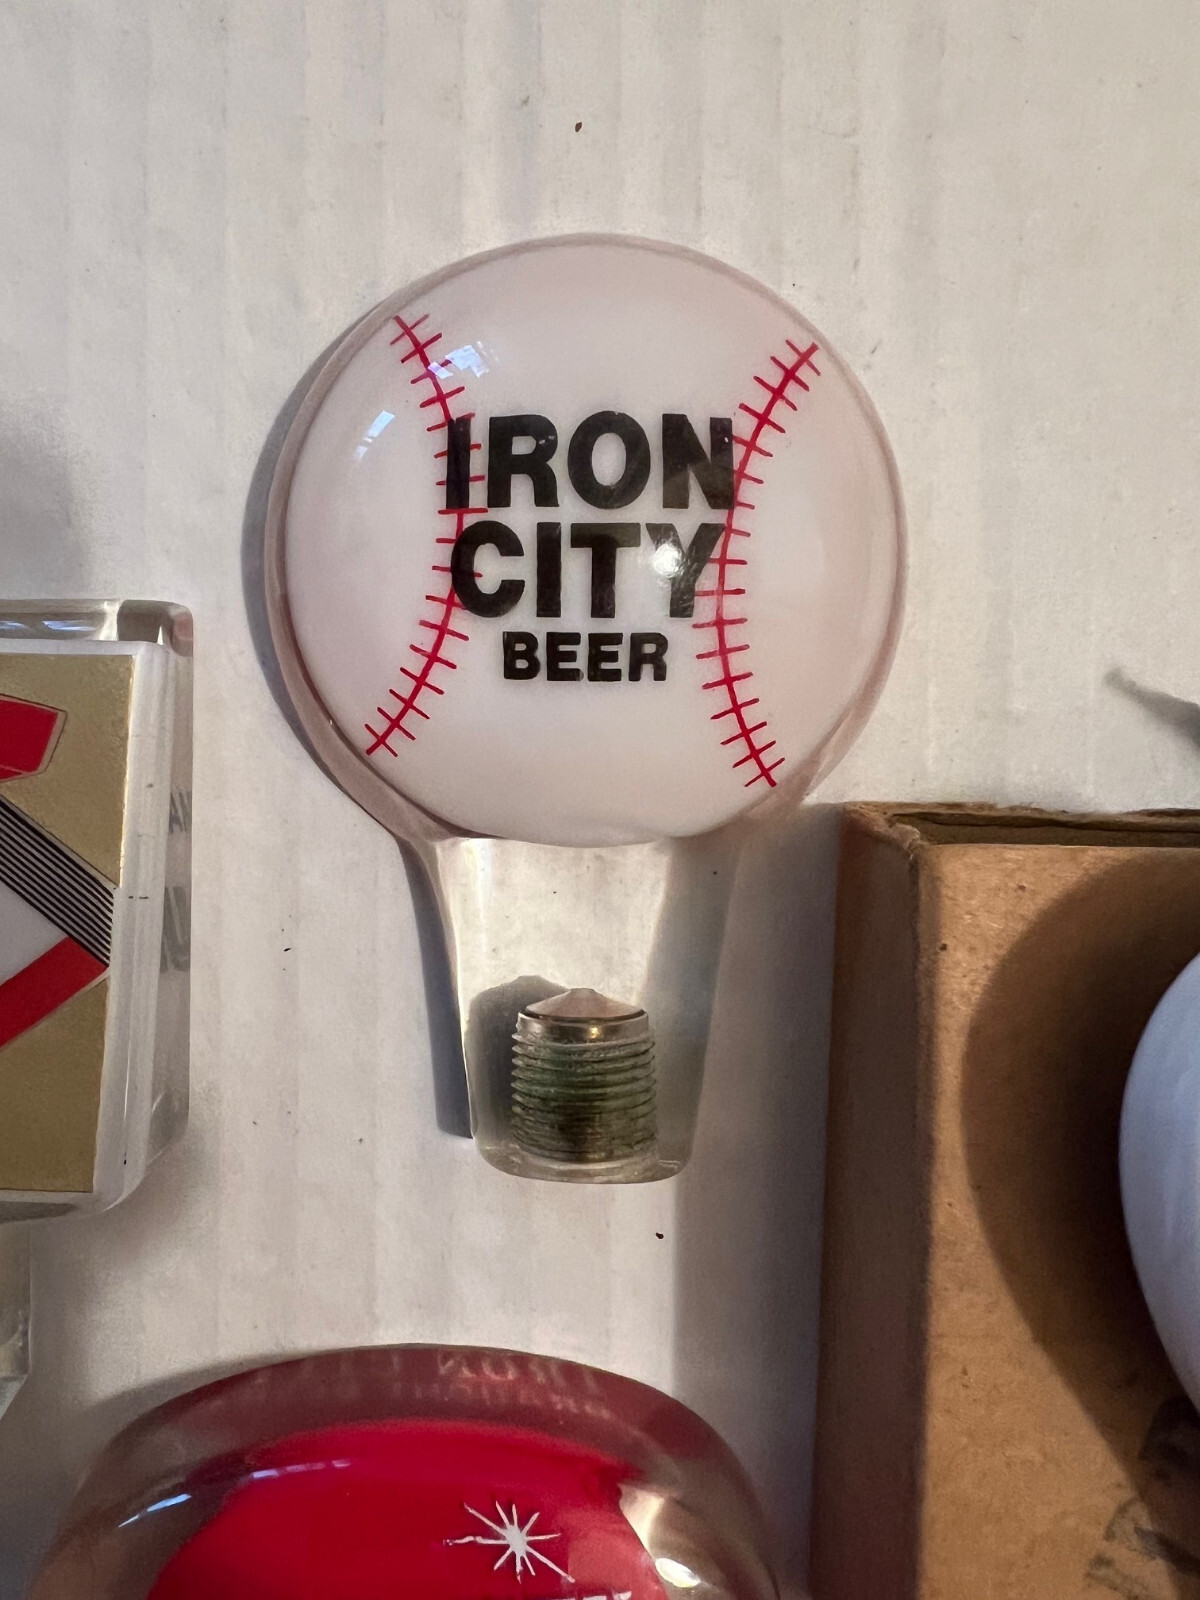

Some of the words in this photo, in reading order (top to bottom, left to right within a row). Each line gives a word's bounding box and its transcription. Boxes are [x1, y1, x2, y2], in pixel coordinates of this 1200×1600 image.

[445, 410, 734, 510] IRON
[451, 520, 726, 618] CITY
[502, 631, 668, 682] BEER
